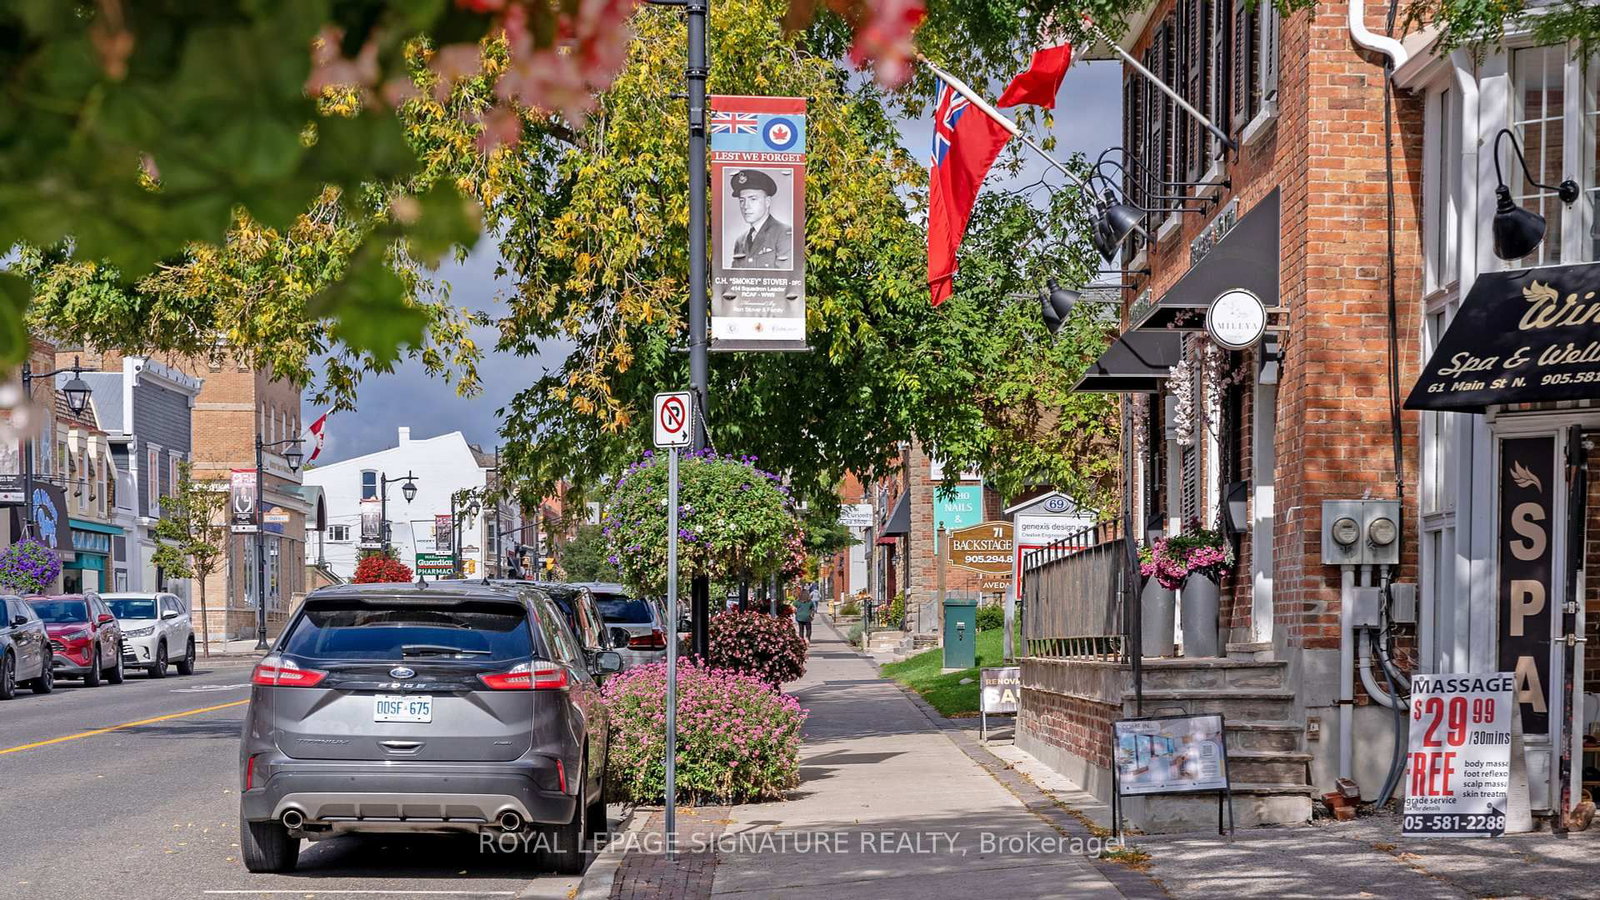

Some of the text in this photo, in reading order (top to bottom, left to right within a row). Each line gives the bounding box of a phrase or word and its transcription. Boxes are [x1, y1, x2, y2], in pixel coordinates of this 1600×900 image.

[715, 152, 801, 162] LEST WE FORGET
[763, 278, 788, 286] STOVER
[1438, 351, 1499, 379] Spa
[1503, 346, 1531, 369] &
[1427, 382, 1446, 394] 61
[1450, 380, 1485, 393] Main
[1489, 378, 1509, 390] St
[1511, 377, 1527, 389] N.
[944, 504, 973, 512] NAILS
[1049, 500, 1064, 509] 69
[954, 515, 962, 523] &
[1021, 523, 1049, 531] genexis
[1051, 523, 1076, 531] design
[992, 527, 1003, 538] 71
[953, 540, 1012, 551] BACKSTAGE
[1509, 502, 1547, 713] SPA
[1412, 678, 1513, 694] MASSAGE
[409, 702, 430, 715] 675
[1469, 730, 1511, 745] /30mins
[1464, 760, 1485, 769] body
[1464, 770, 1480, 778] foot
[1463, 780, 1483, 789] scalp
[1462, 790, 1479, 798] skin
[1430, 797, 1457, 805] service
